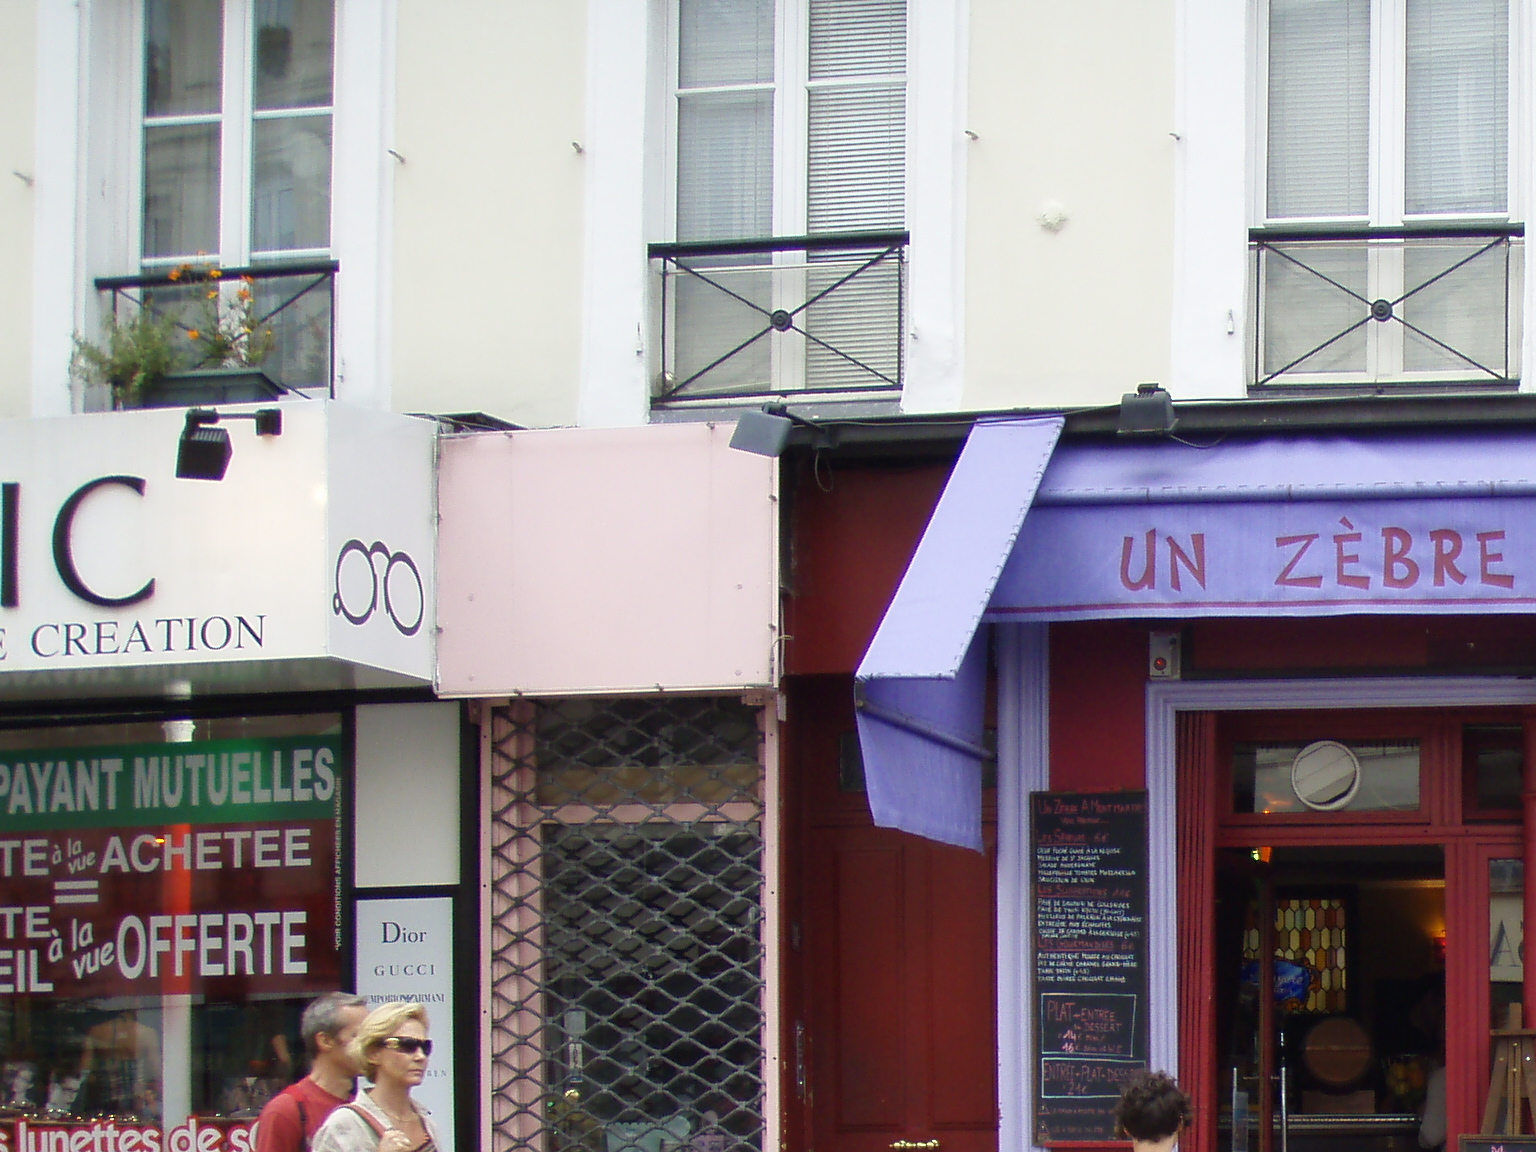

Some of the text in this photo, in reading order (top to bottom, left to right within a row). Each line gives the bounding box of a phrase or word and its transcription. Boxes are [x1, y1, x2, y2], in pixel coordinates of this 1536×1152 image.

[1119, 526, 1206, 592] UN
[1274, 515, 1516, 591] ZÈBRE
[30, 614, 268, 659] CREATION
[133, 747, 335, 809] MUTUELLES
[52, 843, 62, 865] à
[67, 838, 82, 855] la
[68, 850, 97, 875] vue
[100, 828, 312, 874] ACHETEE
[49, 928, 63, 963] à
[71, 918, 93, 951] la
[116, 911, 308, 980] OFFERTE
[381, 921, 427, 944] Dior
[72, 938, 116, 980] vue
[374, 964, 436, 977] GUCCI
